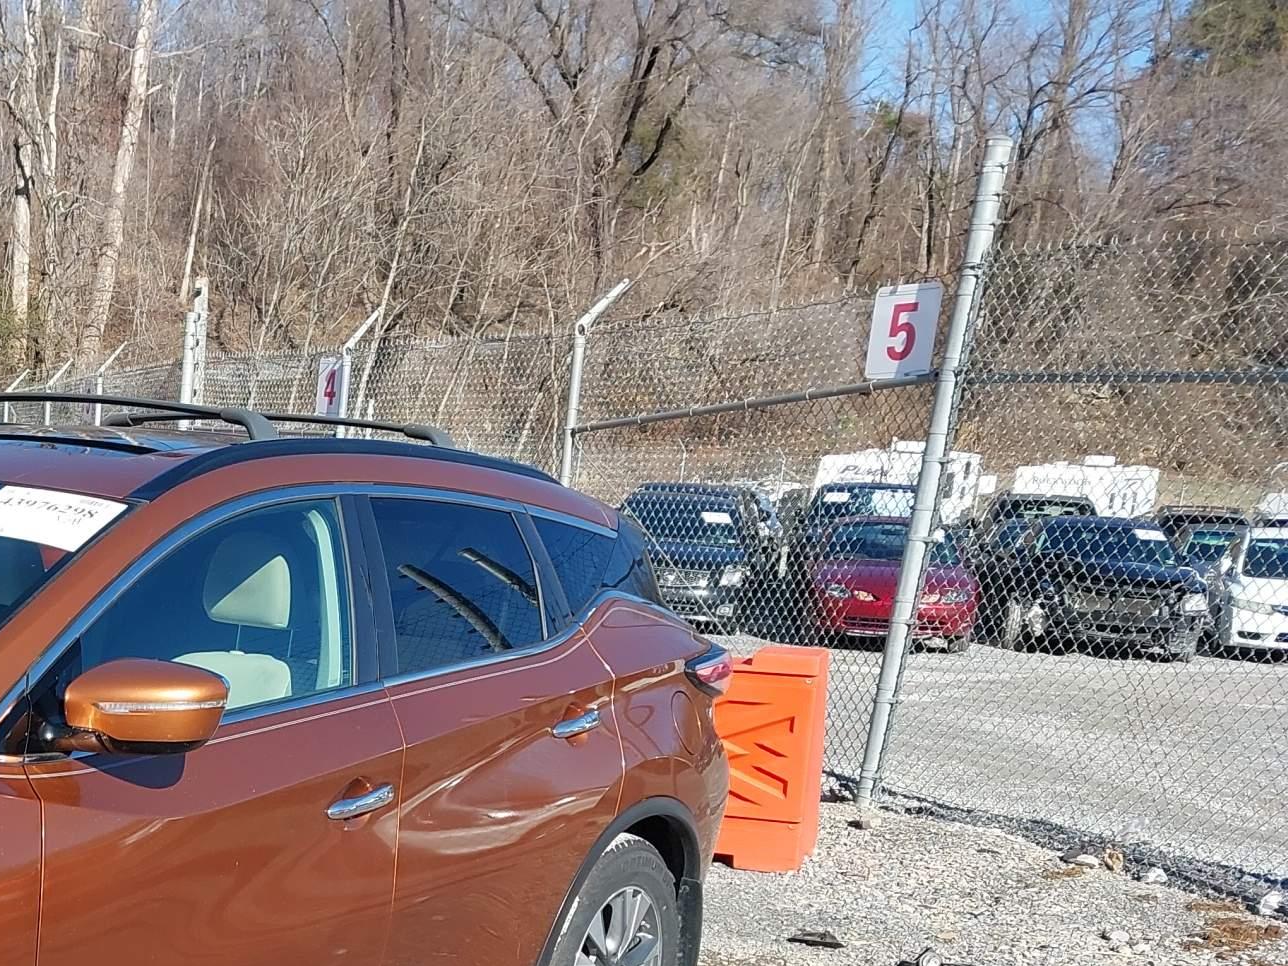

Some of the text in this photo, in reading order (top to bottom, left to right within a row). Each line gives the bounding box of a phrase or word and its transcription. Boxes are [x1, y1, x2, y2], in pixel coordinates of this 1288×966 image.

[886, 302, 920, 361] 5
[323, 368, 337, 406] 4
[0, 496, 99, 519] 43976298
